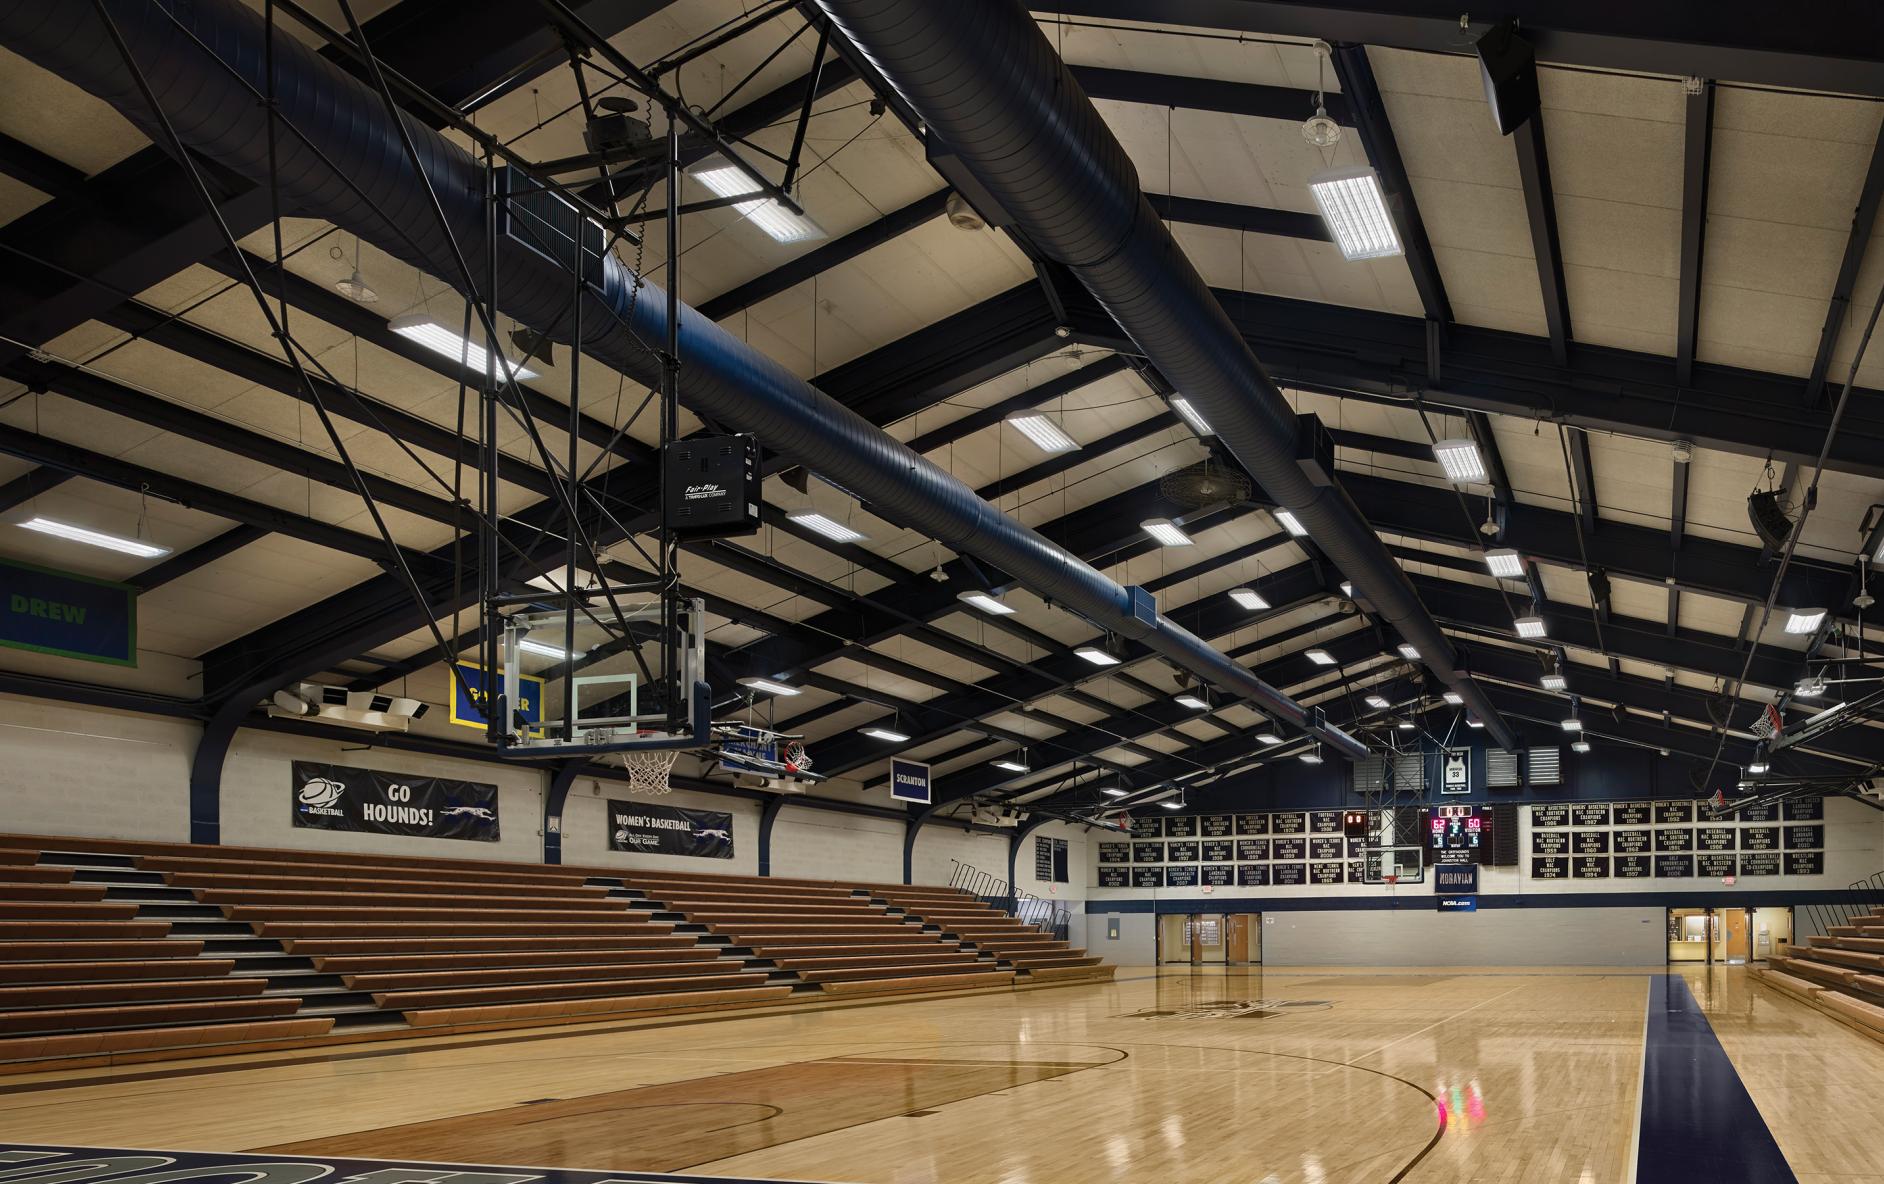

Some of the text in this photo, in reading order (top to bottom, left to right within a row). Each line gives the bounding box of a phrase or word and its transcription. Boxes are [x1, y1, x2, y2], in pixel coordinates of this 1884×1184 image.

[686, 484, 718, 493] Fair-Play
[11, 593, 87, 624] DREW
[896, 774, 926, 787] SCRANTON
[388, 784, 410, 802] GO
[308, 806, 344, 816] BASKETBALL
[364, 803, 433, 826] HOUNDS!
[616, 814, 690, 831] WOMEN'S BASKETBALL
[1434, 820, 1445, 828] 62
[1469, 819, 1479, 828] 60
[1440, 873, 1472, 884] MORAVIAN
